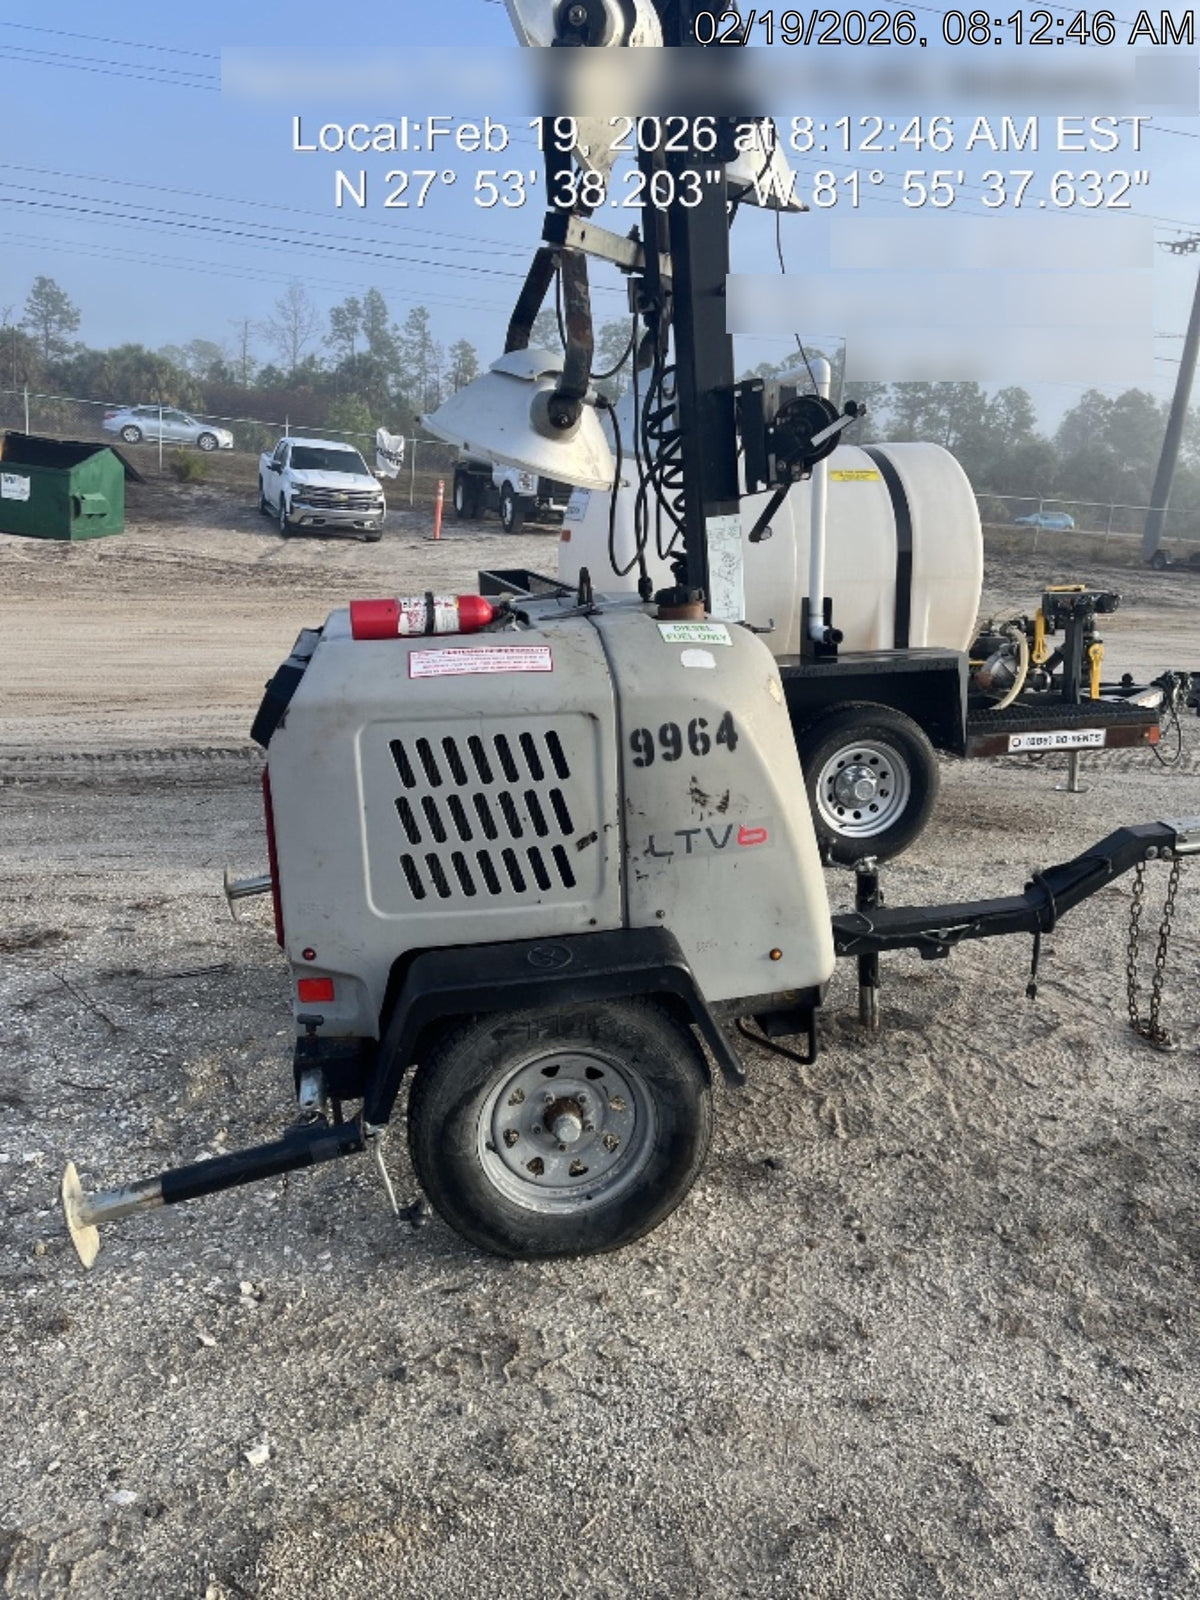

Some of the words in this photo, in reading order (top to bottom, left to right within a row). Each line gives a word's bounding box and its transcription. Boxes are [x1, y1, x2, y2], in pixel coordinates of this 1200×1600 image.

[673, 624, 712, 632] DIESEL
[666, 632, 694, 641] FUEL
[698, 632, 727, 641] ONLY
[629, 710, 739, 768] 9964
